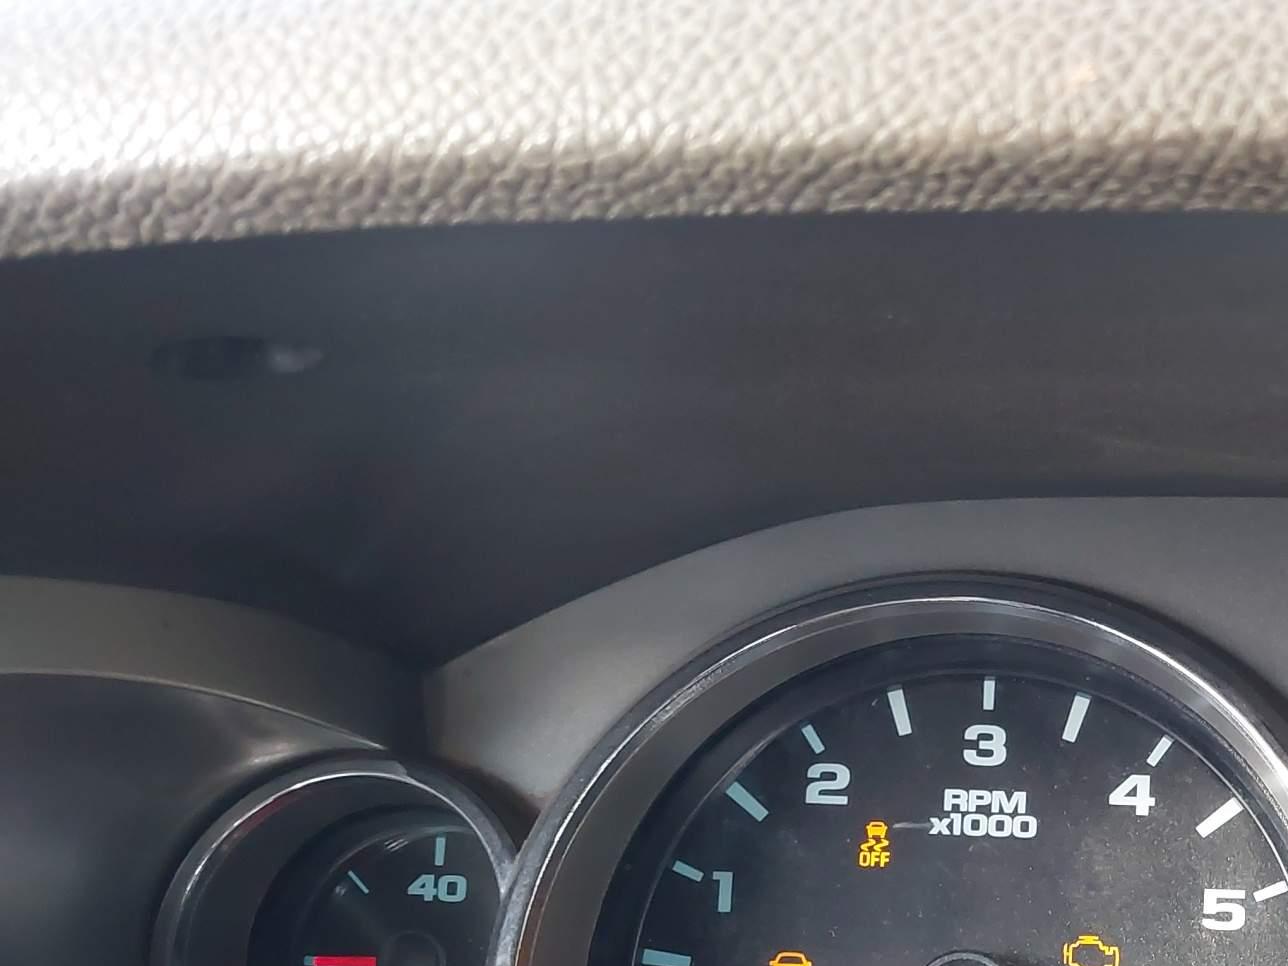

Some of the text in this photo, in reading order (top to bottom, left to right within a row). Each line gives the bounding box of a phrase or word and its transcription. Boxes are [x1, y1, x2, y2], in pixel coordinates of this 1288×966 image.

[963, 725, 1007, 767] 3
[805, 763, 850, 805] 2
[944, 788, 1027, 814] RPM
[1108, 774, 1156, 816] 4
[929, 813, 1038, 839] x1000
[858, 851, 891, 868] OFF
[407, 874, 467, 903] 40
[712, 871, 733, 912] 1
[1202, 889, 1246, 931] 5
